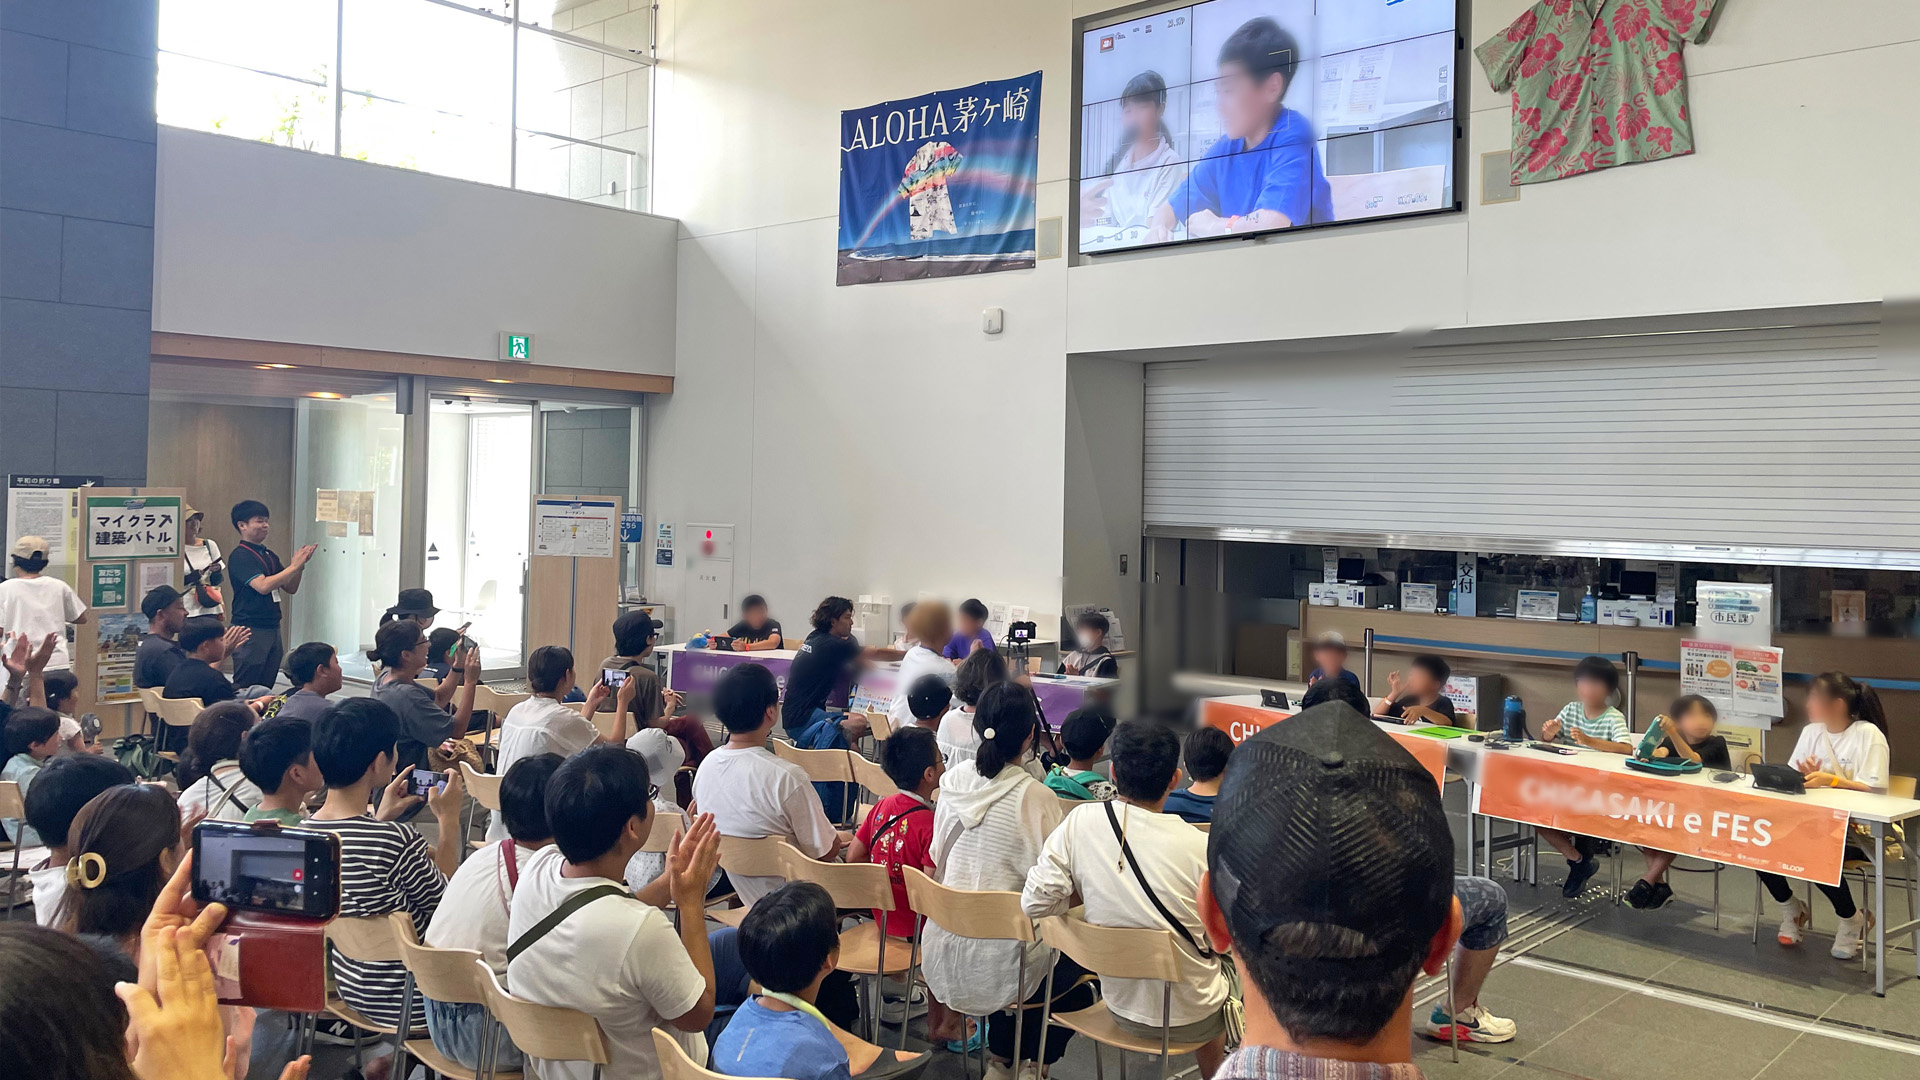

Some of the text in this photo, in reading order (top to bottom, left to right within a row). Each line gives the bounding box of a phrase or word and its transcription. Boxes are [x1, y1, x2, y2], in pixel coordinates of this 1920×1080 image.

[841, 102, 949, 152] ALOHA
[97, 514, 156, 528] マイクラ
[95, 531, 171, 545] 建築バトル
[1459, 561, 1474, 594] 交付
[1714, 611, 1749, 623] 市民課
[1683, 812, 1702, 834] e
[1711, 810, 1772, 847] FES
